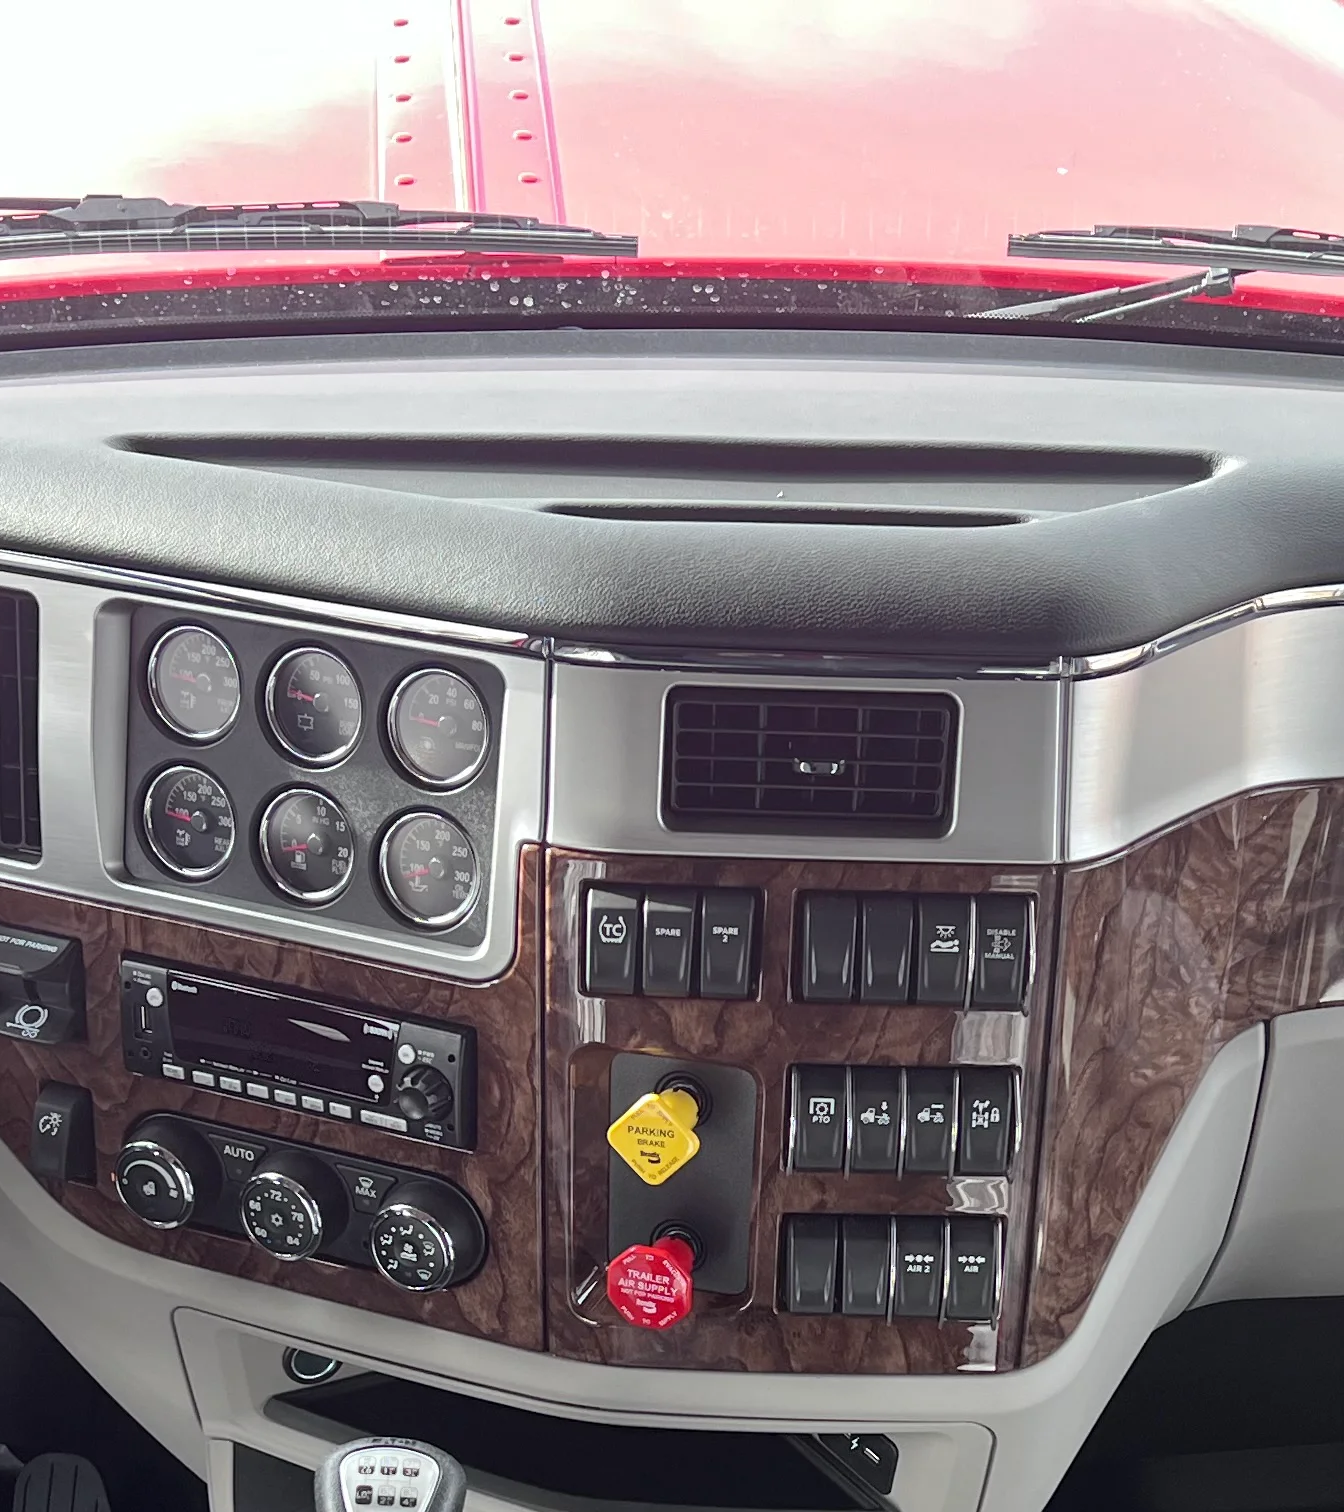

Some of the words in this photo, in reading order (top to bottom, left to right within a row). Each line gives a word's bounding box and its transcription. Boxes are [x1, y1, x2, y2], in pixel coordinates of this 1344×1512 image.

[201, 644, 216, 655] 200
[216, 656, 230, 668] 250
[310, 670, 320, 680] 50
[336, 674, 350, 686] 100
[223, 677, 237, 688] 300
[446, 688, 457, 698] 40
[344, 697, 358, 709] 150
[428, 694, 439, 705] 20
[464, 699, 475, 710] 60
[472, 720, 483, 731] 80
[197, 784, 212, 795] 200
[183, 791, 197, 802] 150
[211, 796, 226, 807] 250
[317, 806, 326, 817] 10
[336, 821, 345, 832] 15
[435, 830, 451, 841] 200
[416, 840, 430, 851] 150
[338, 847, 348, 858] 20
[452, 846, 468, 858] 250
[454, 871, 470, 882] 300
[604, 924, 622, 936] TC
[655, 927, 681, 937] SPARE
[712, 927, 739, 935] SPARE
[722, 935, 728, 943] 2
[9, 937, 26, 946] FOR
[25, 941, 58, 953] PARKING
[984, 952, 1015, 960] MANUAL
[812, 1115, 831, 1123] PTO
[627, 1125, 675, 1139] PARKING
[637, 1138, 666, 1148] BRAKE
[224, 1145, 255, 1161] AUTO
[269, 1189, 283, 1202] 72
[356, 1186, 377, 1199] MAX
[291, 1211, 304, 1223] 78
[906, 1265, 923, 1273] AIR
[923, 1265, 930, 1273] 2
[963, 1265, 979, 1273] AIR
[627, 1268, 670, 1285] TRAILER
[618, 1277, 636, 1288] AIR
[637, 1281, 678, 1297] SUPPLY
[620, 1287, 634, 1295] NOT
[634, 1289, 647, 1297] FOR
[647, 1292, 675, 1303] PARKING
[658, 1310, 678, 1326] SUPPLY
